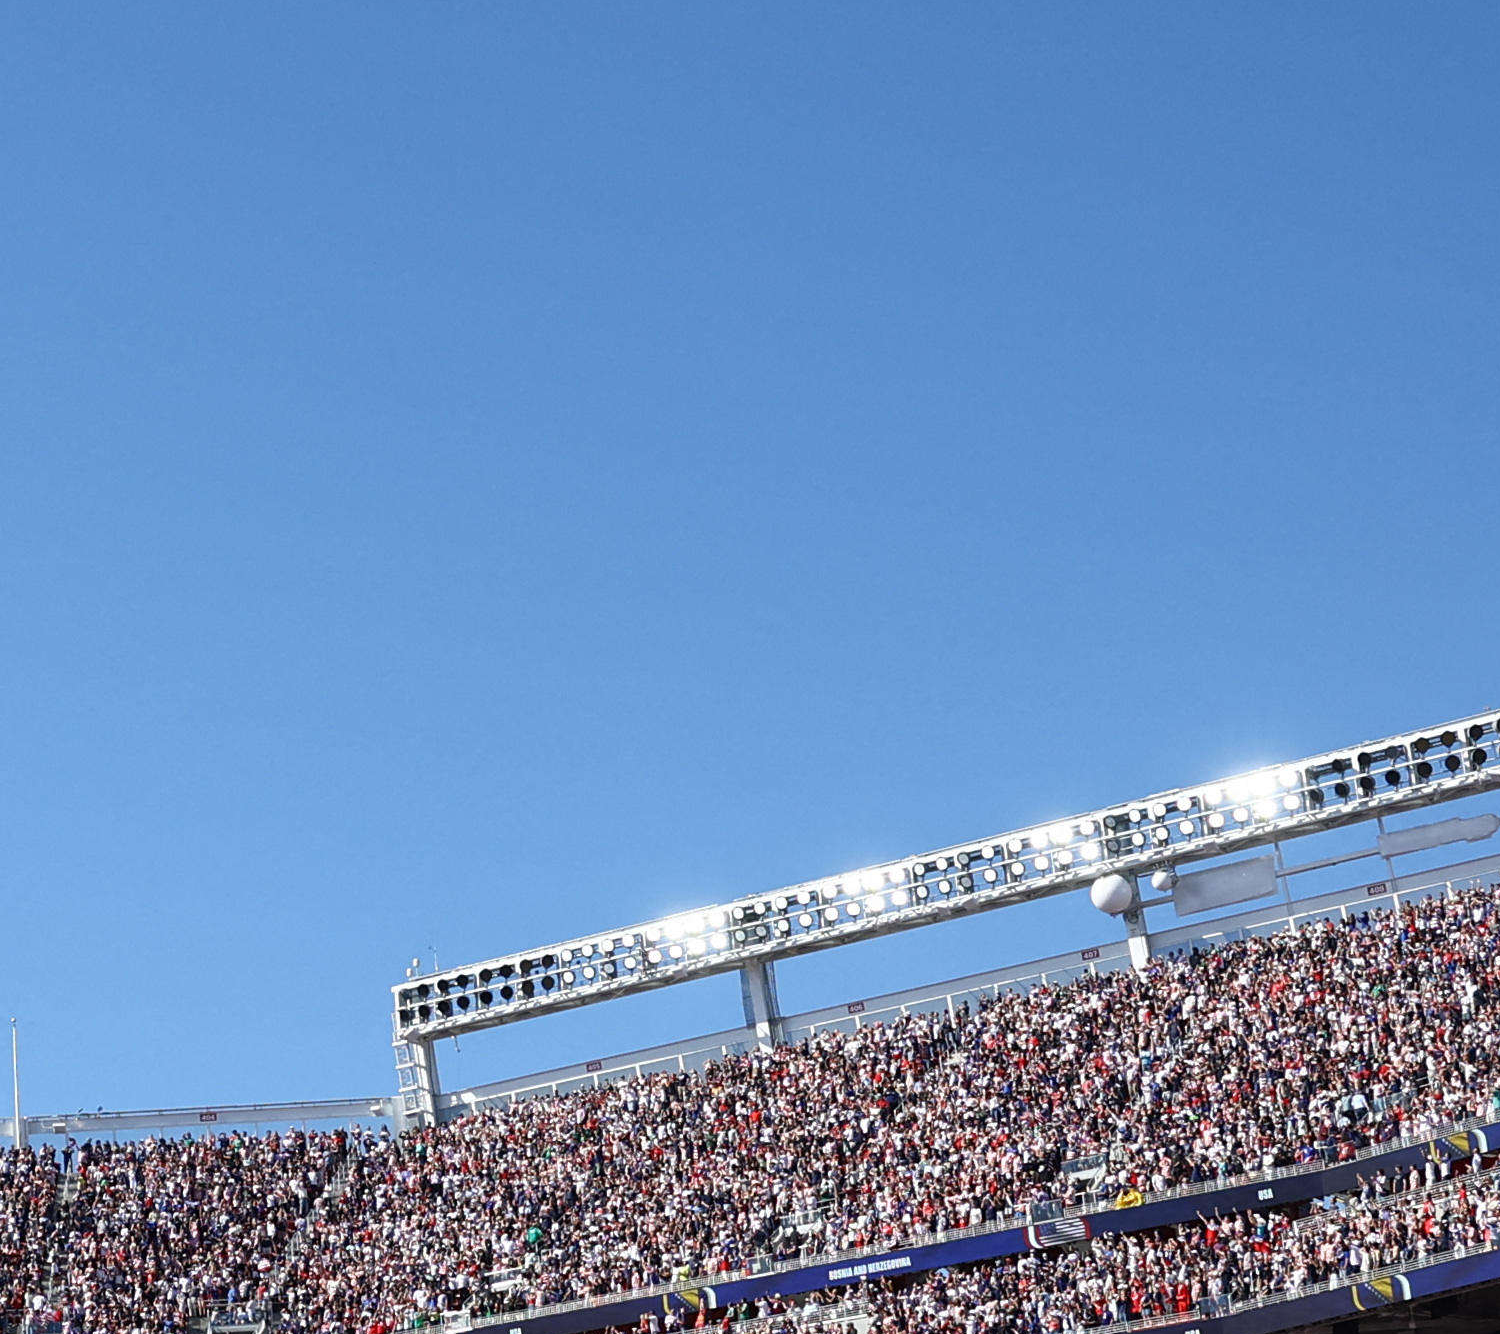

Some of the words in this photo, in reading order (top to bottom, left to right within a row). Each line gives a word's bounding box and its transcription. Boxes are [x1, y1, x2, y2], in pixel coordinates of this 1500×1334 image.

[1258, 1189, 1273, 1200] USA
[829, 1267, 853, 1280] BOSNIA
[854, 1265, 867, 1277] AND
[868, 1257, 911, 1273] HERZEGOVINA
